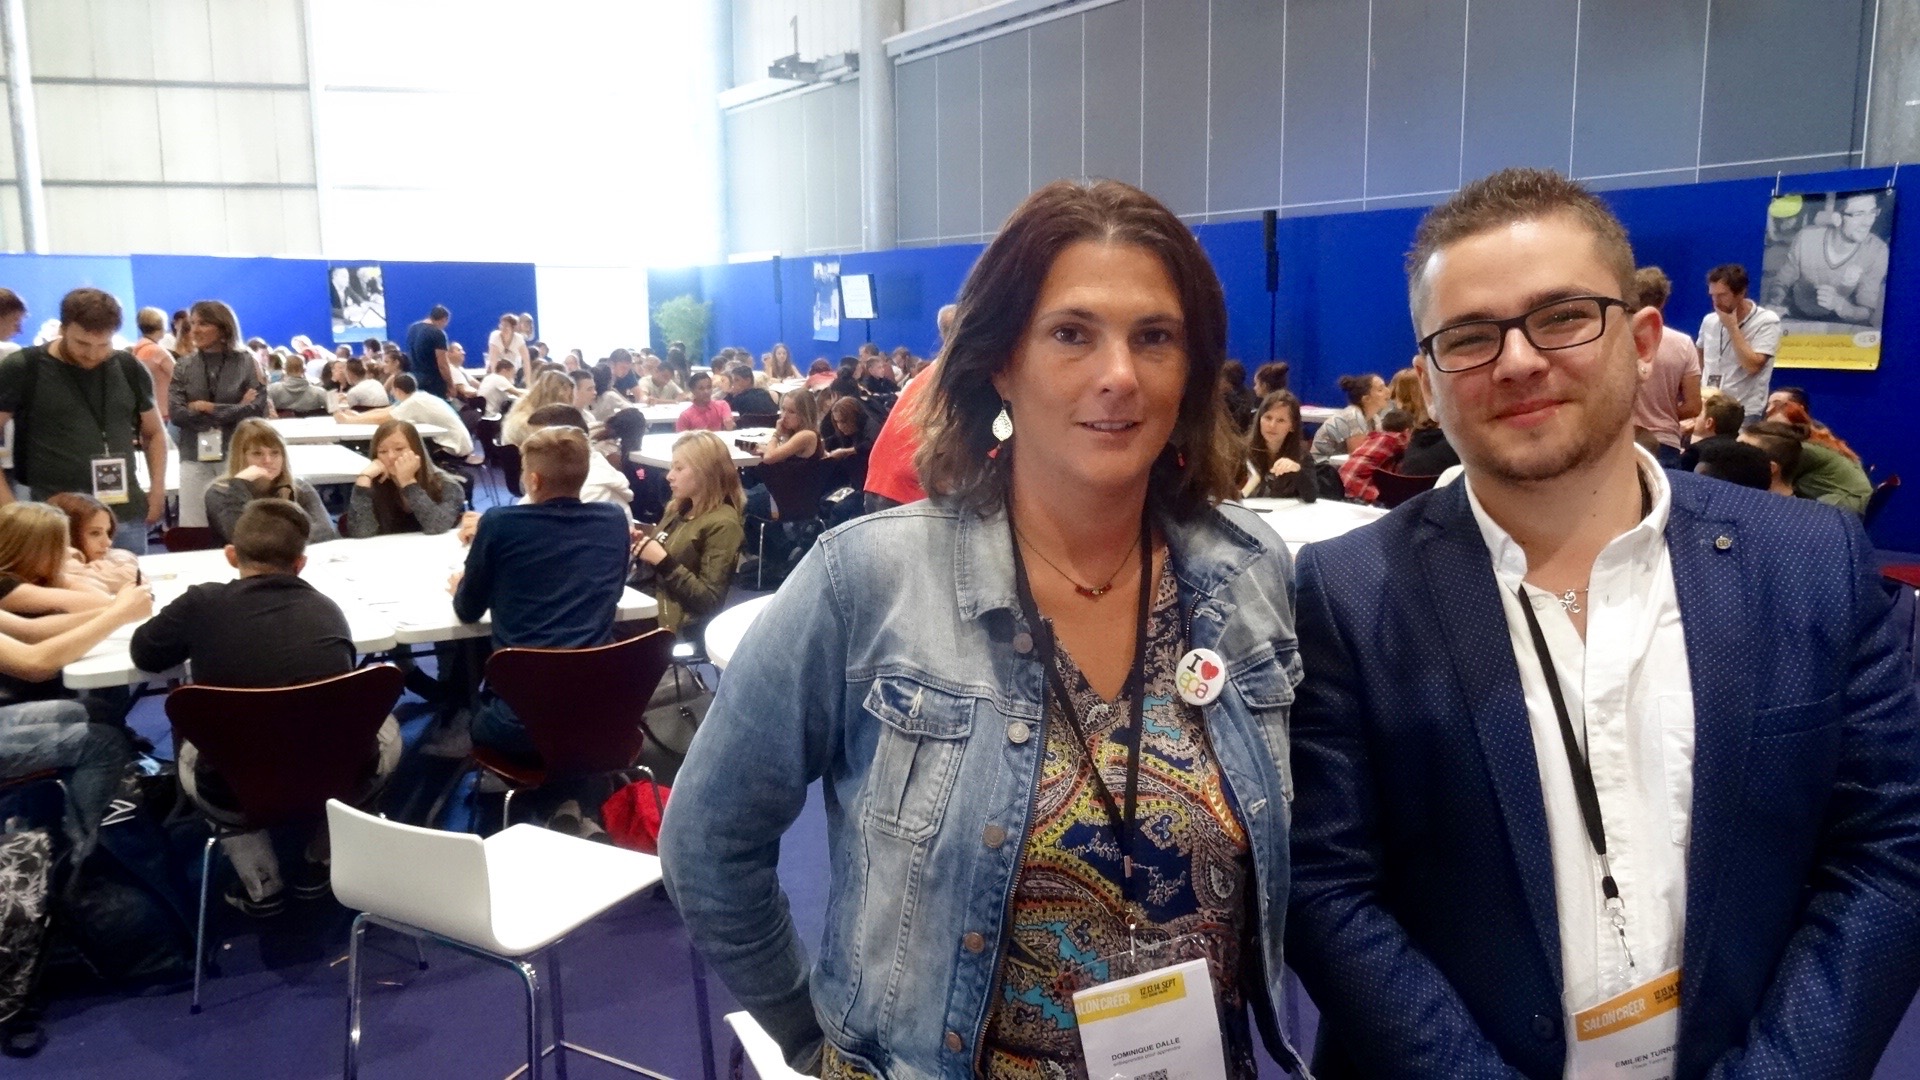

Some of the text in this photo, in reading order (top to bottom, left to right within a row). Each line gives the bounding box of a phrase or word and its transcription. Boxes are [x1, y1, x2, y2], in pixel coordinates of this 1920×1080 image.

[1583, 1011, 1616, 1032] SALON
[1111, 1037, 1180, 1061] DOMINIQUE DALLE
[1615, 1054, 1649, 1068] EMILIEN
